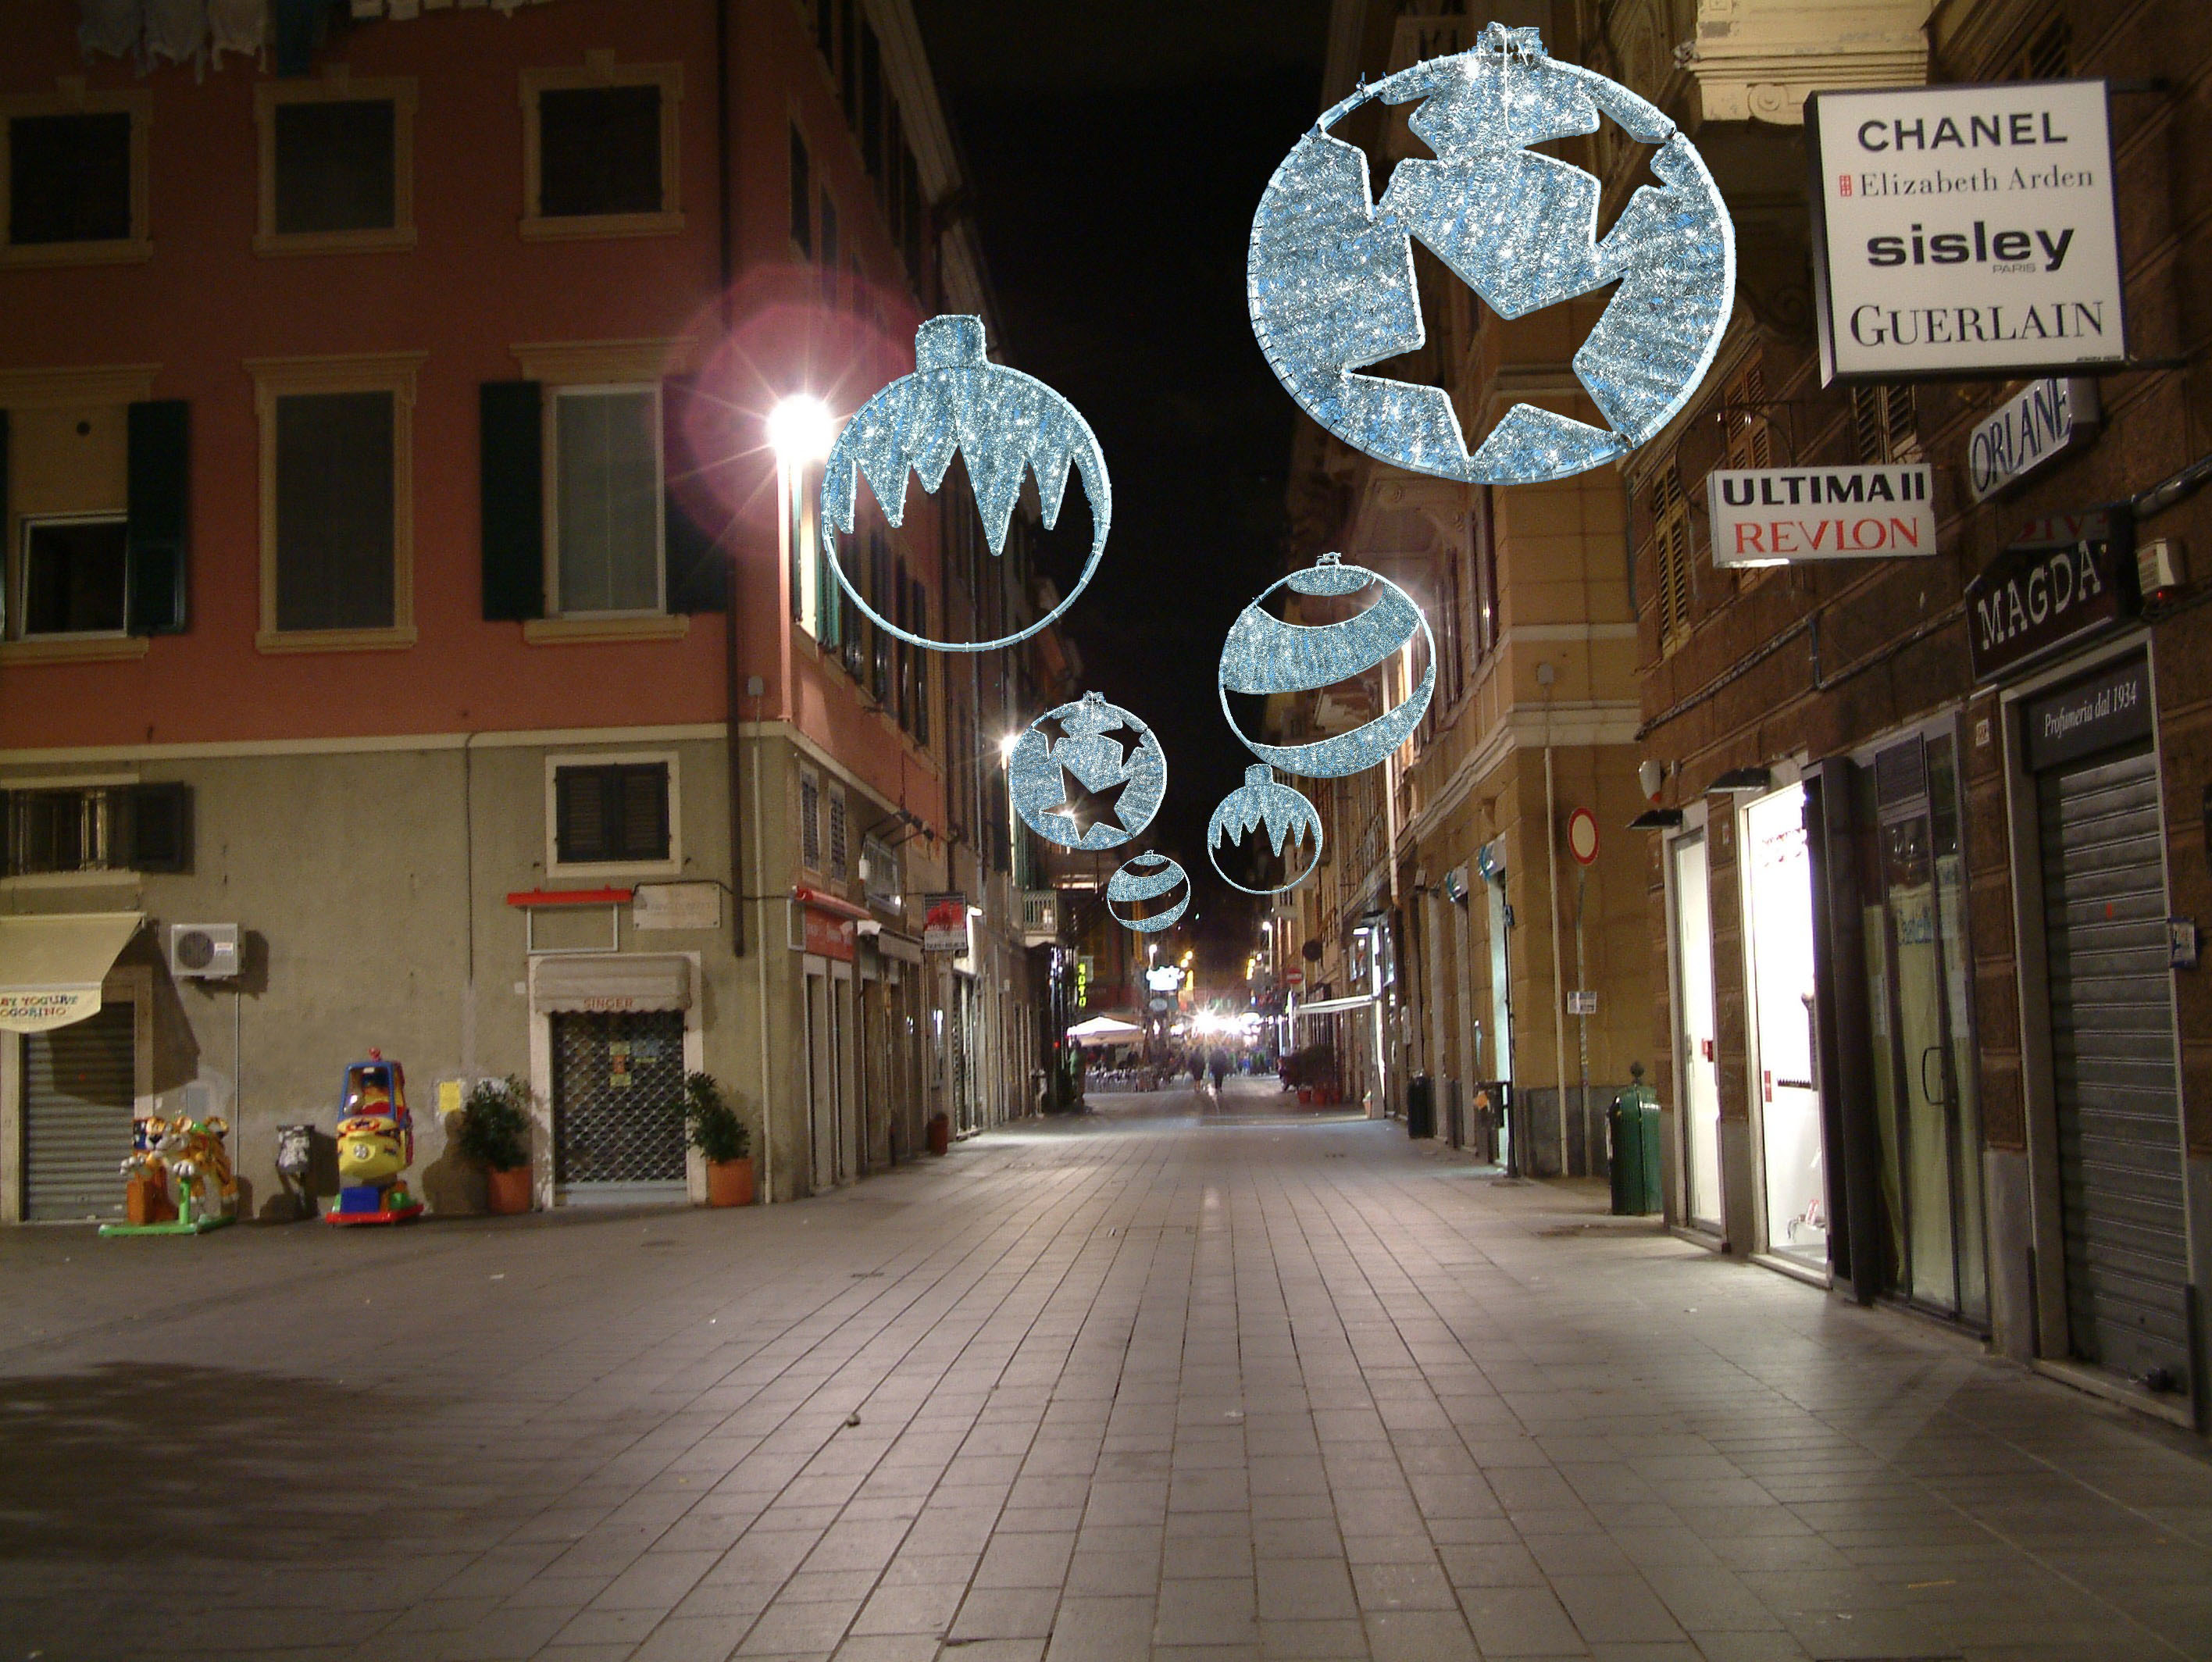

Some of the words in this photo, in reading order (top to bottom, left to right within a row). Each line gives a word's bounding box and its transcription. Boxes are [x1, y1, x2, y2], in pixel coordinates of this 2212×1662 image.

[1857, 112, 2068, 152] CHANEL
[1861, 169, 2000, 198] Elizabeth
[2007, 164, 2094, 191] Arden
[1866, 220, 2075, 272] sisley
[1992, 264, 2038, 275] PARIS
[1971, 378, 2072, 493] ORLANE
[1735, 516, 1919, 555] REVLON
[1977, 540, 2101, 650] MAGDA
[2043, 700, 2093, 740] Profumeria
[2094, 691, 2110, 719] dal
[2112, 679, 2138, 713] 1934
